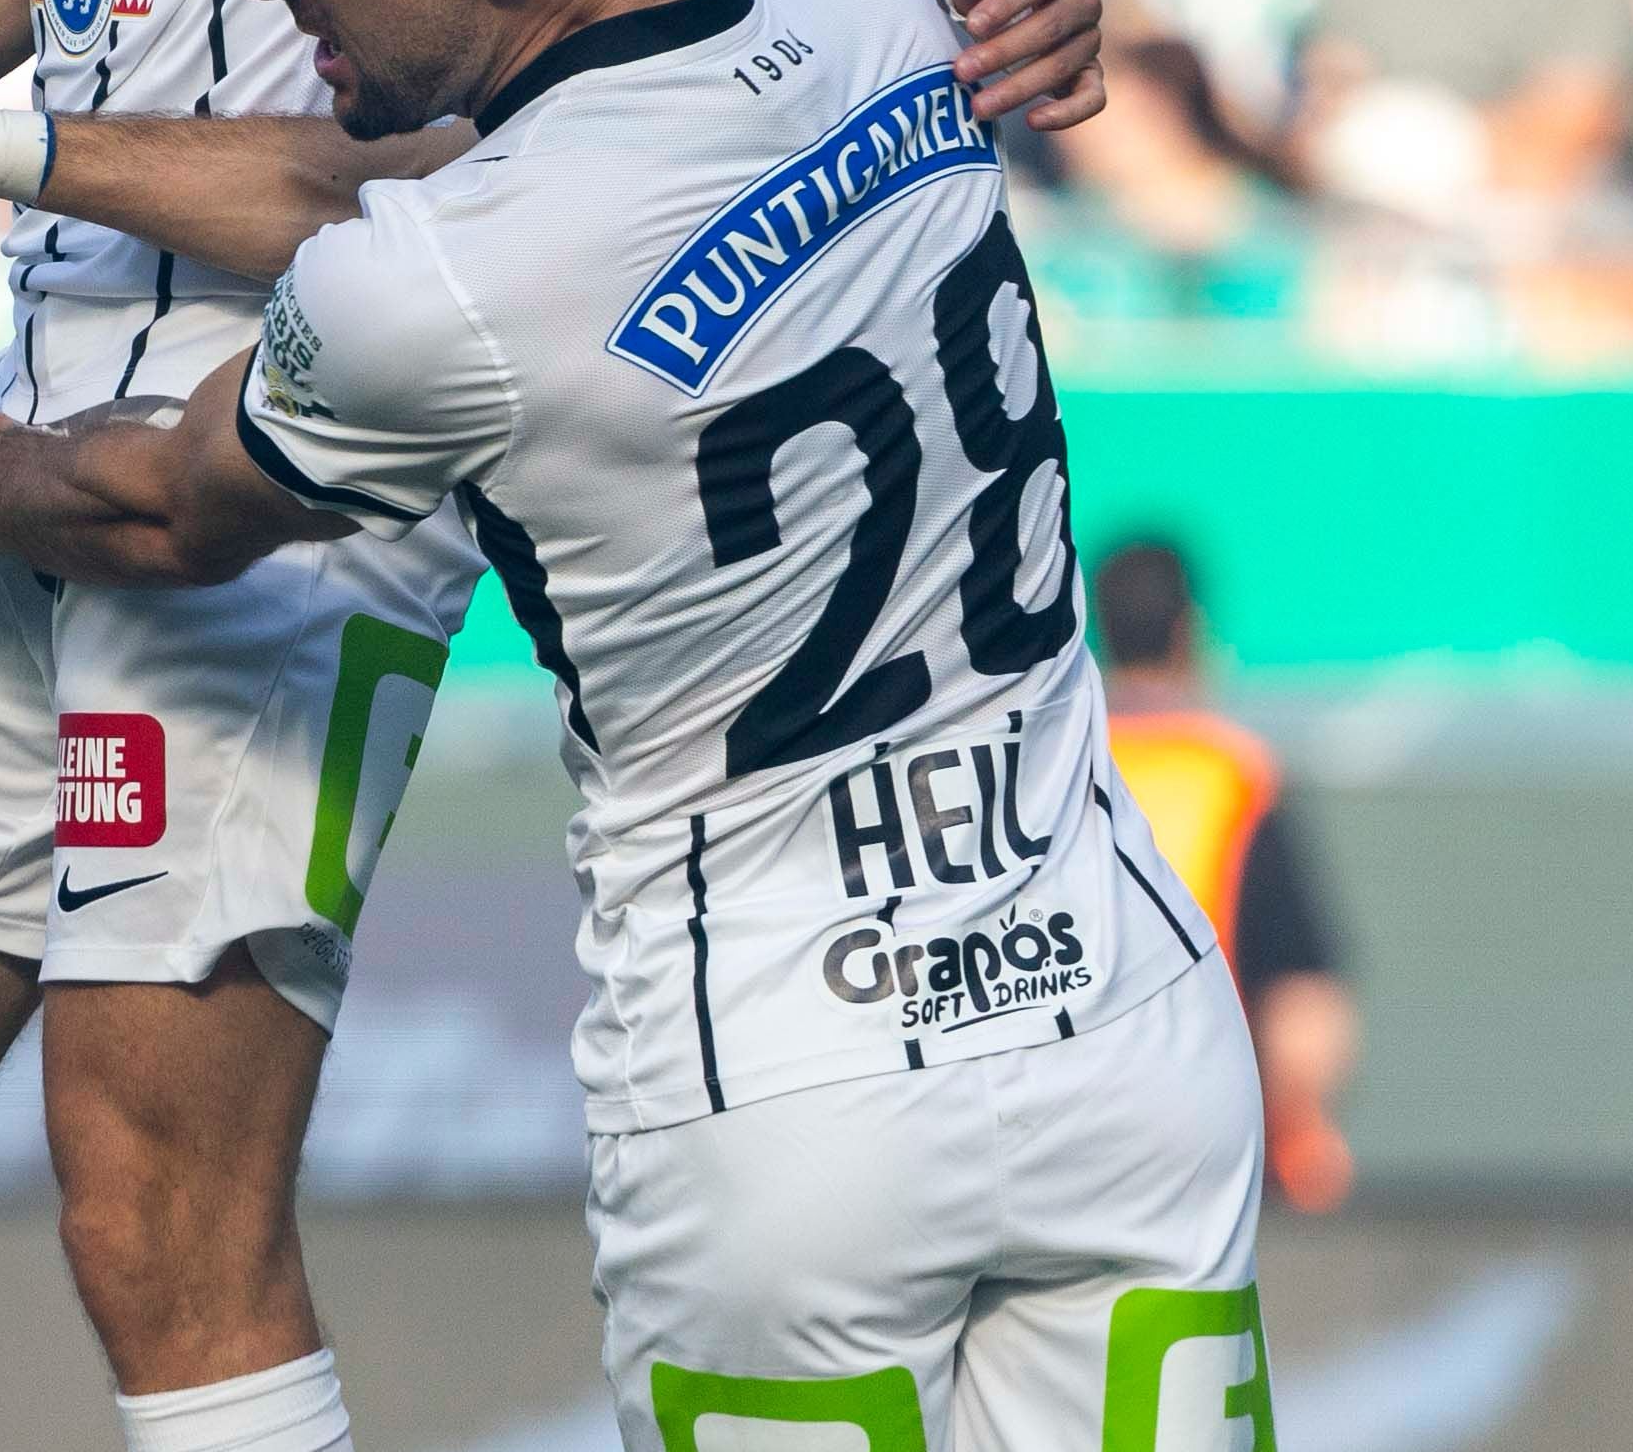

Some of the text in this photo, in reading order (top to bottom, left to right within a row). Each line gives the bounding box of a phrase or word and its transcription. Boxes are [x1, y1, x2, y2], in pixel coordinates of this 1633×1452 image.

[638, 81, 988, 366] PUNTIGAMER
[697, 209, 1078, 780] 28
[829, 741, 1053, 899] HEIL
[901, 967, 1092, 1028] SOFT DRINKS
